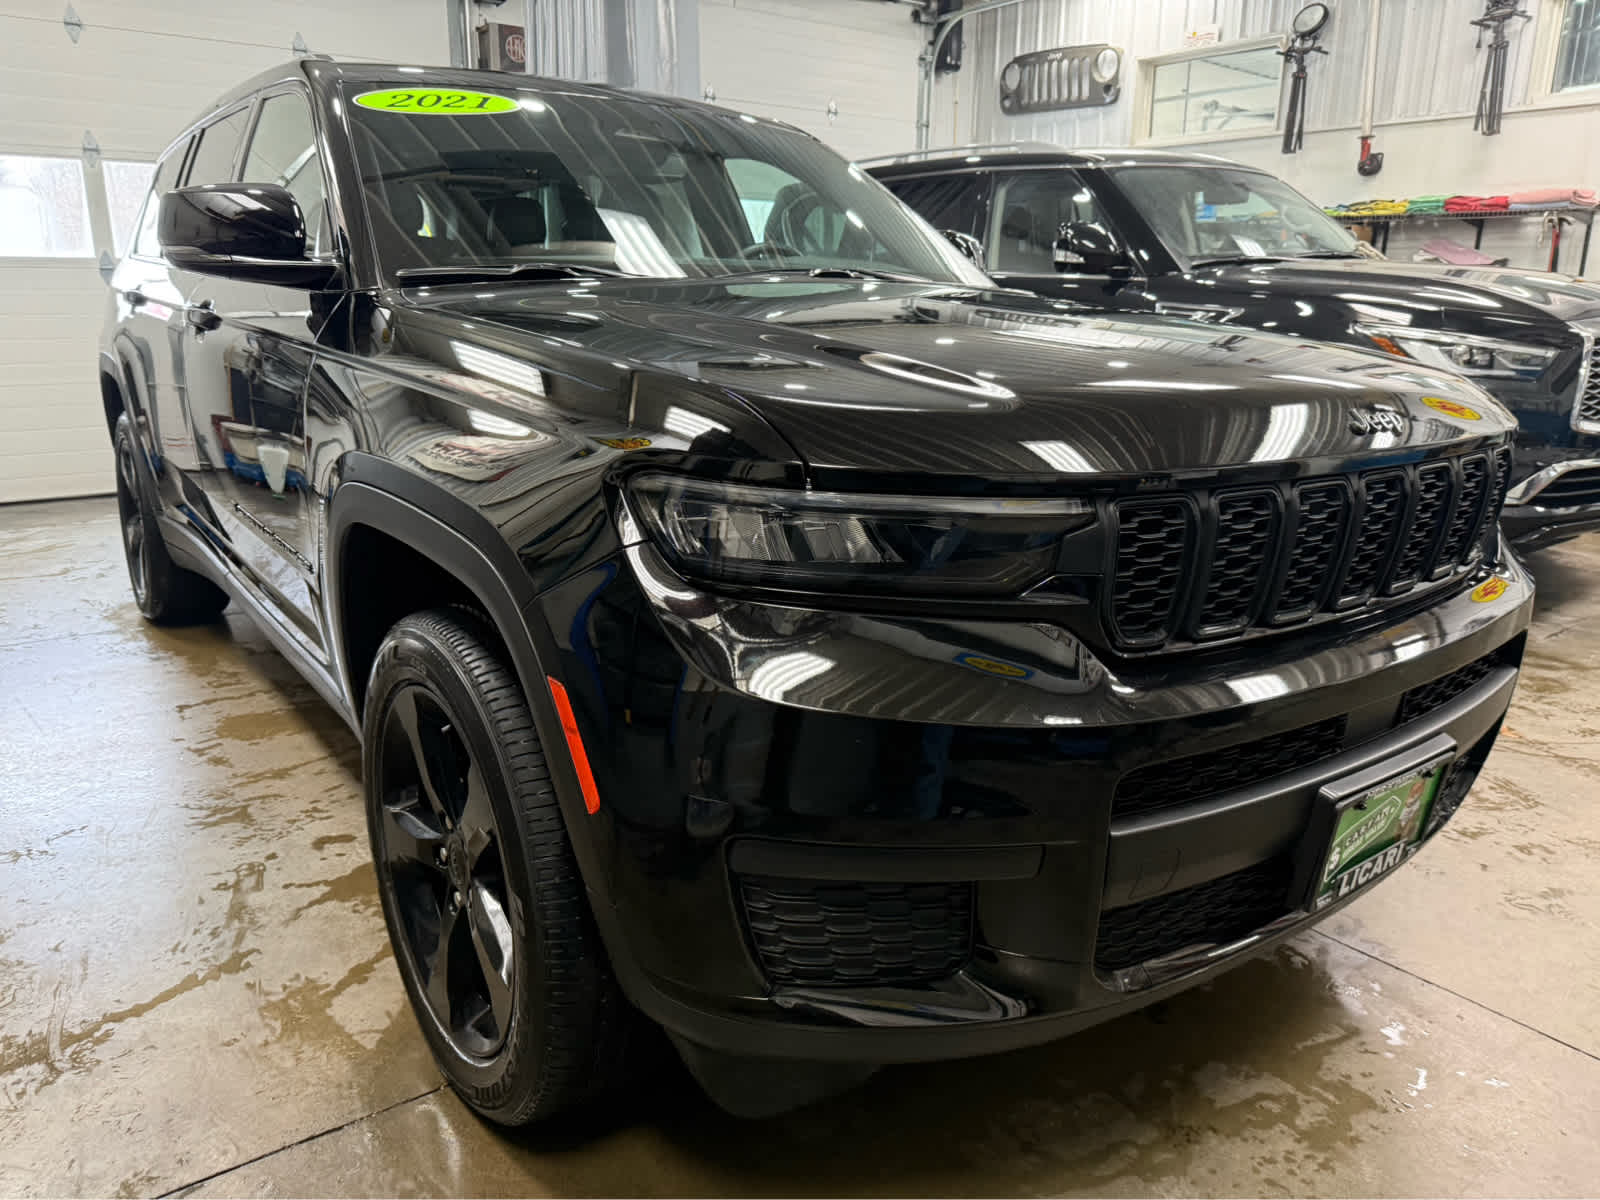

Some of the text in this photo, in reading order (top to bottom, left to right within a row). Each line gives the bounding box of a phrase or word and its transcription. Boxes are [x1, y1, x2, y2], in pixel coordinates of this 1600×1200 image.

[386, 94, 491, 109] 2021
[1350, 407, 1403, 434] Jeep
[1338, 842, 1406, 897] LICARI
